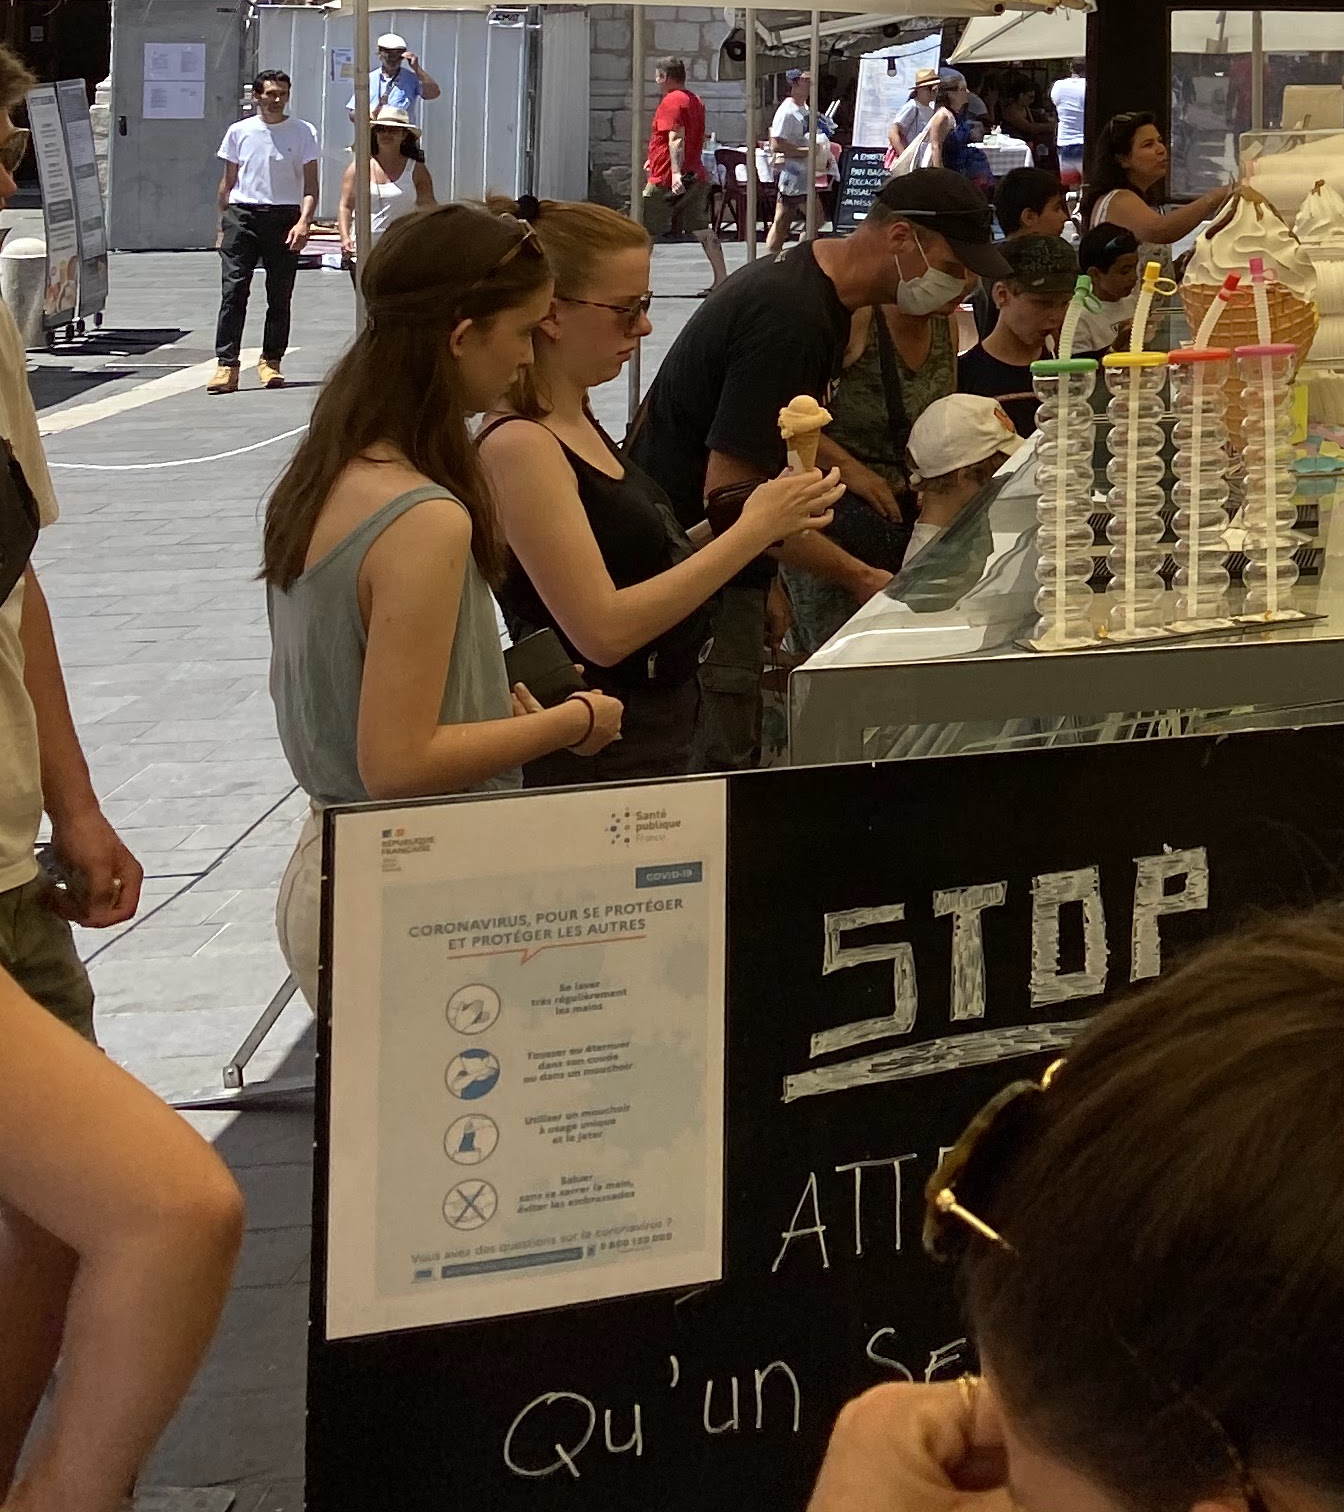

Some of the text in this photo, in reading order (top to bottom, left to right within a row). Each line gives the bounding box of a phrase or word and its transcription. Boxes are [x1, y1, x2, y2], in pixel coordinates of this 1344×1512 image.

[635, 808, 667, 821] Santé
[635, 819, 682, 834] publique
[646, 868, 693, 882] COVID-19
[408, 897, 684, 938] CORONAVIRUS, POUR SE PROTÉGER
[448, 918, 646, 951] ET PROTÉGER LES AUTRES
[810, 845, 1209, 1059] STOP
